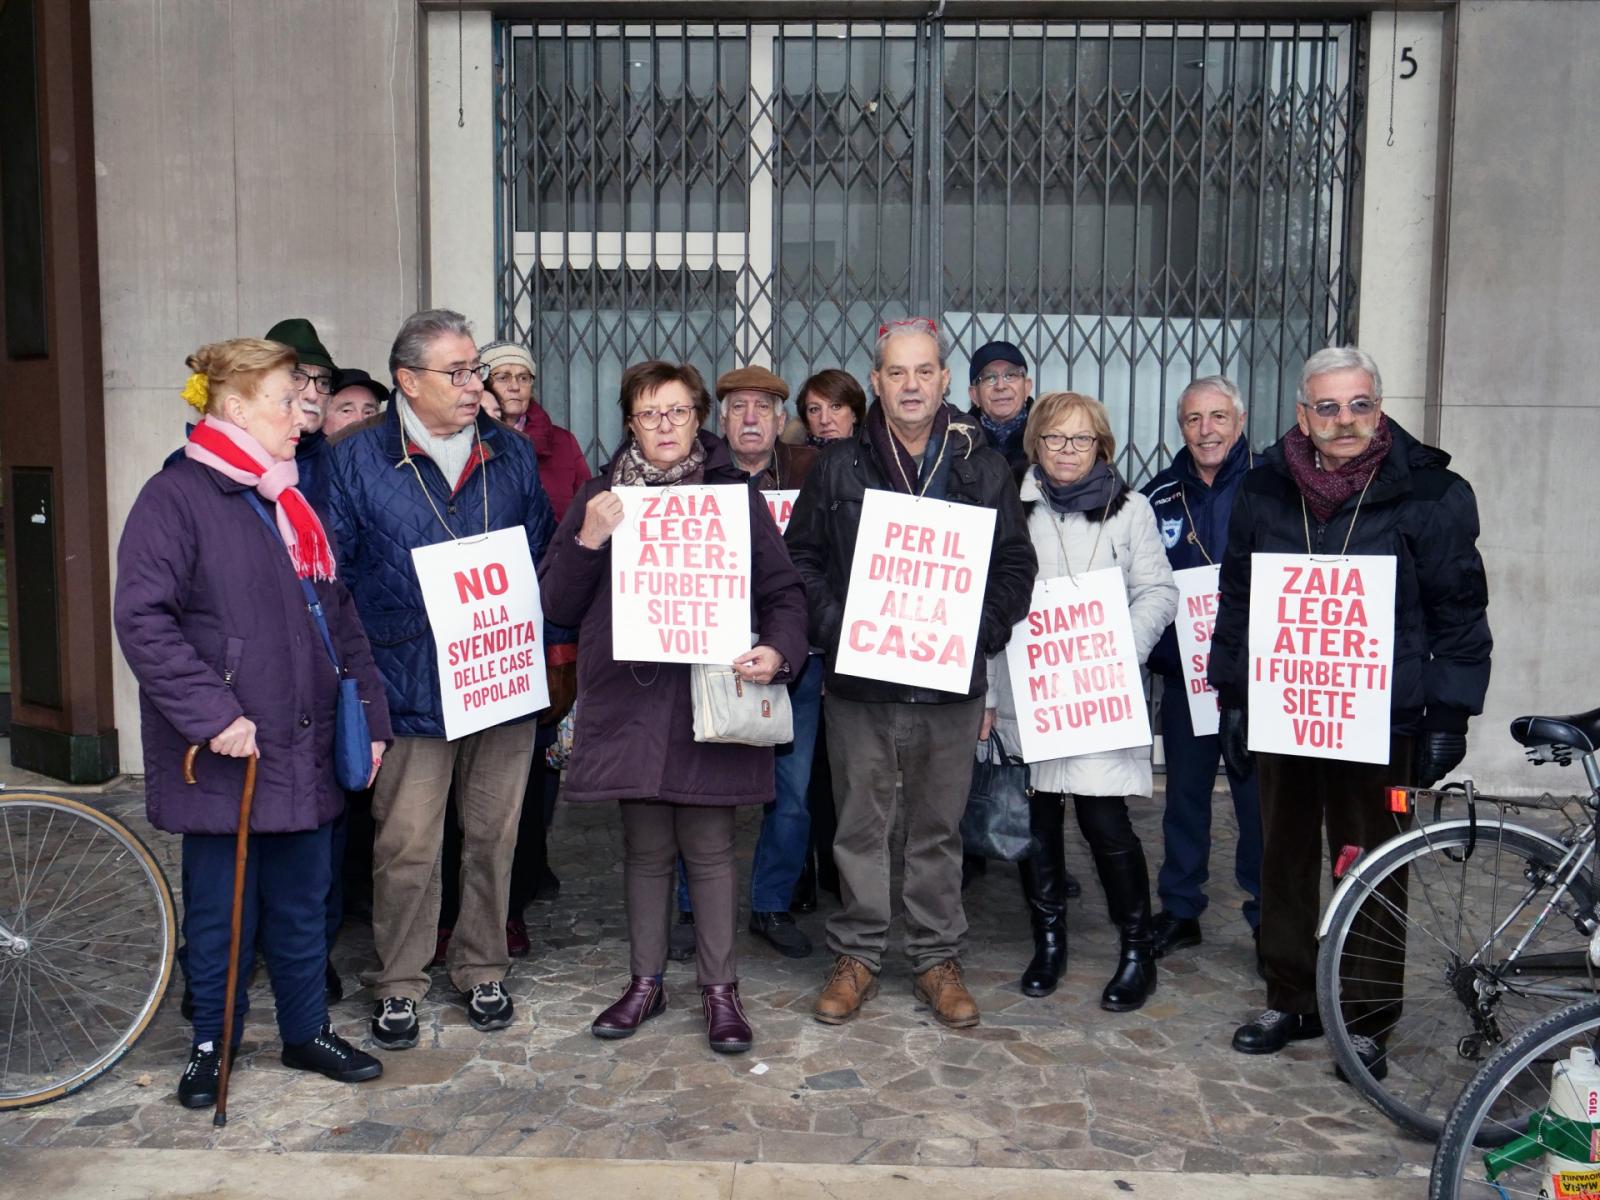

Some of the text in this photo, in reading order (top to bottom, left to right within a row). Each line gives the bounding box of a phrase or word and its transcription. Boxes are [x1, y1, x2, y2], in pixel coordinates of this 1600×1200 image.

[1399, 47, 1418, 79] 5
[642, 495, 721, 518] ZAIA
[639, 518, 726, 542] LEGA
[884, 522, 965, 559] PER IL
[638, 543, 738, 570] ATER:
[454, 562, 509, 604] NO
[620, 572, 746, 600] I FURBETTI
[869, 554, 973, 594] DIRITTO
[1281, 566, 1366, 596] ZAIA
[473, 605, 510, 631] ALLA
[648, 600, 719, 627] SIETE
[880, 590, 948, 625] ALLA
[1027, 600, 1106, 637] SIAMO
[1277, 597, 1369, 627] LEGA
[448, 620, 536, 666] SVENDITA
[658, 629, 709, 655] VOI!
[849, 619, 968, 669] CASA
[1273, 626, 1380, 659] ATER:
[454, 651, 534, 690] DELLE CASE
[1028, 661, 1127, 702] MA NON
[1254, 657, 1387, 691] I FURBETTI
[463, 674, 530, 711] POPOLARI
[1283, 687, 1356, 720] SIETE
[1293, 719, 1344, 750] VOI!
[1588, 1091, 1598, 1116] CGIL
